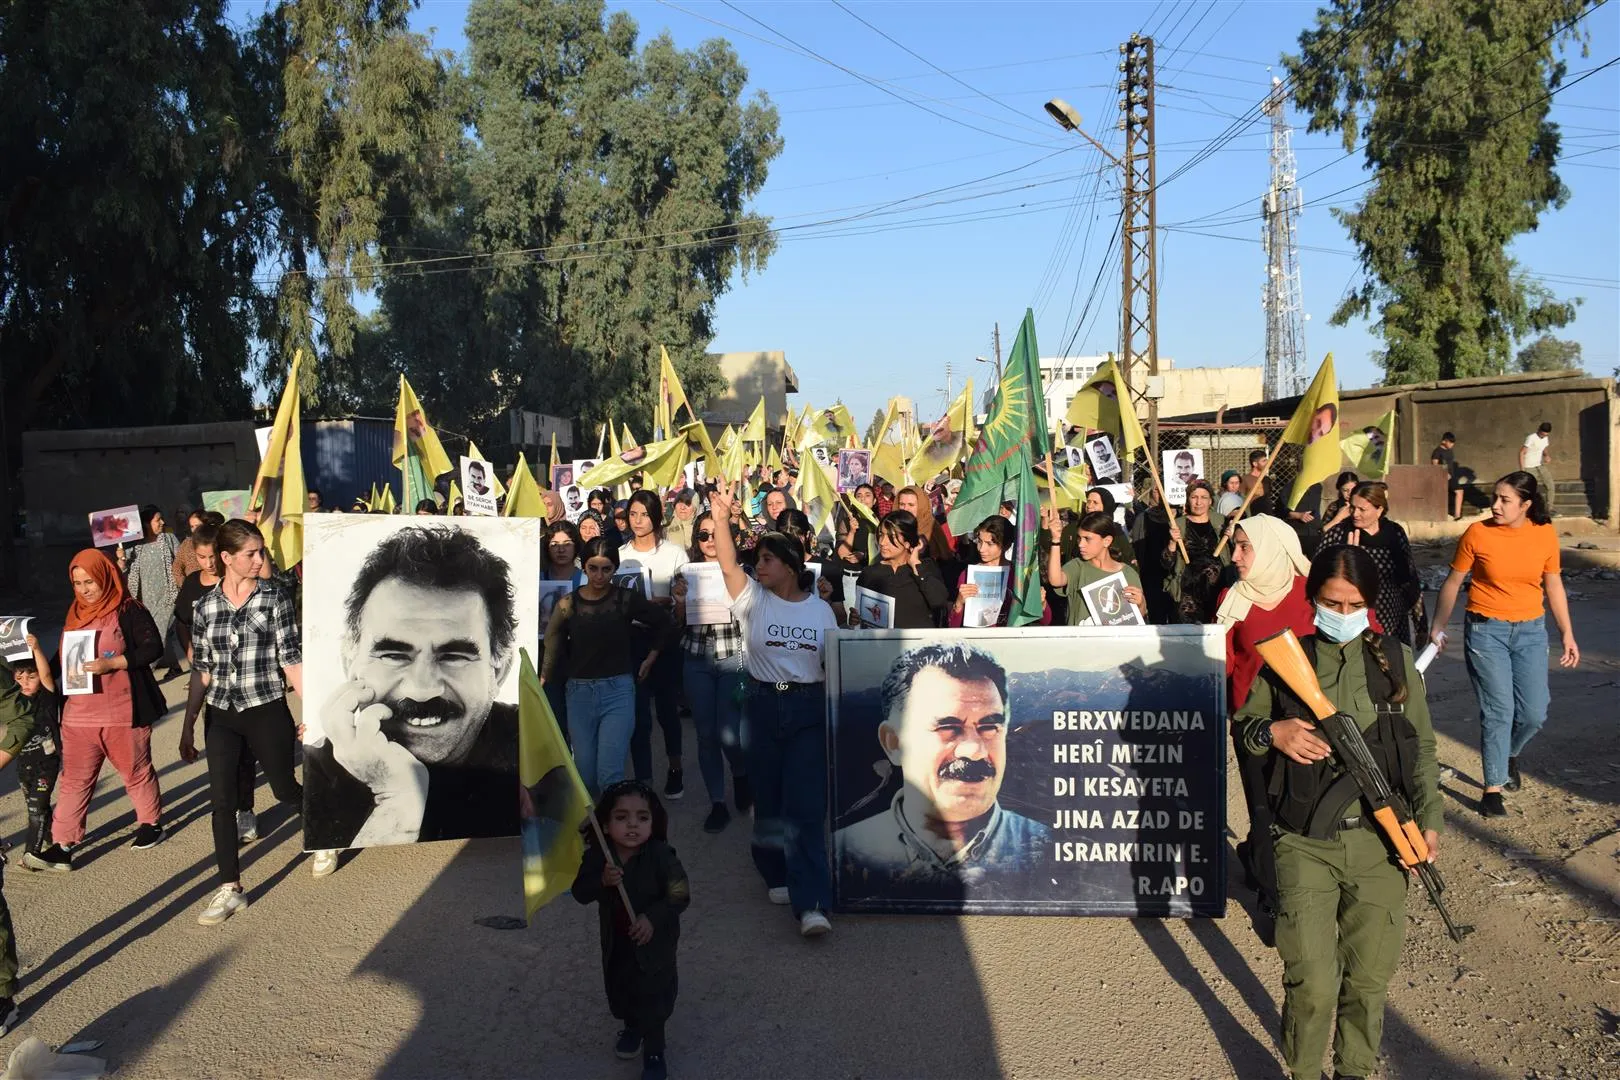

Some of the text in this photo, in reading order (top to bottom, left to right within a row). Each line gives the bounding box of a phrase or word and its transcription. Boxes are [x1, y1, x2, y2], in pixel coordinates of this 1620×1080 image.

[768, 624, 817, 641] GUCCI
[1053, 711, 1205, 731] BERXWEDANA
[1053, 738, 1104, 763] HERÎ
[1054, 777, 1075, 797] DI
[1053, 810, 1204, 830] JINA AZAD DE
[1055, 842, 1208, 863] ISRARKIRIN E.
[1139, 876, 1205, 895] R.APO
